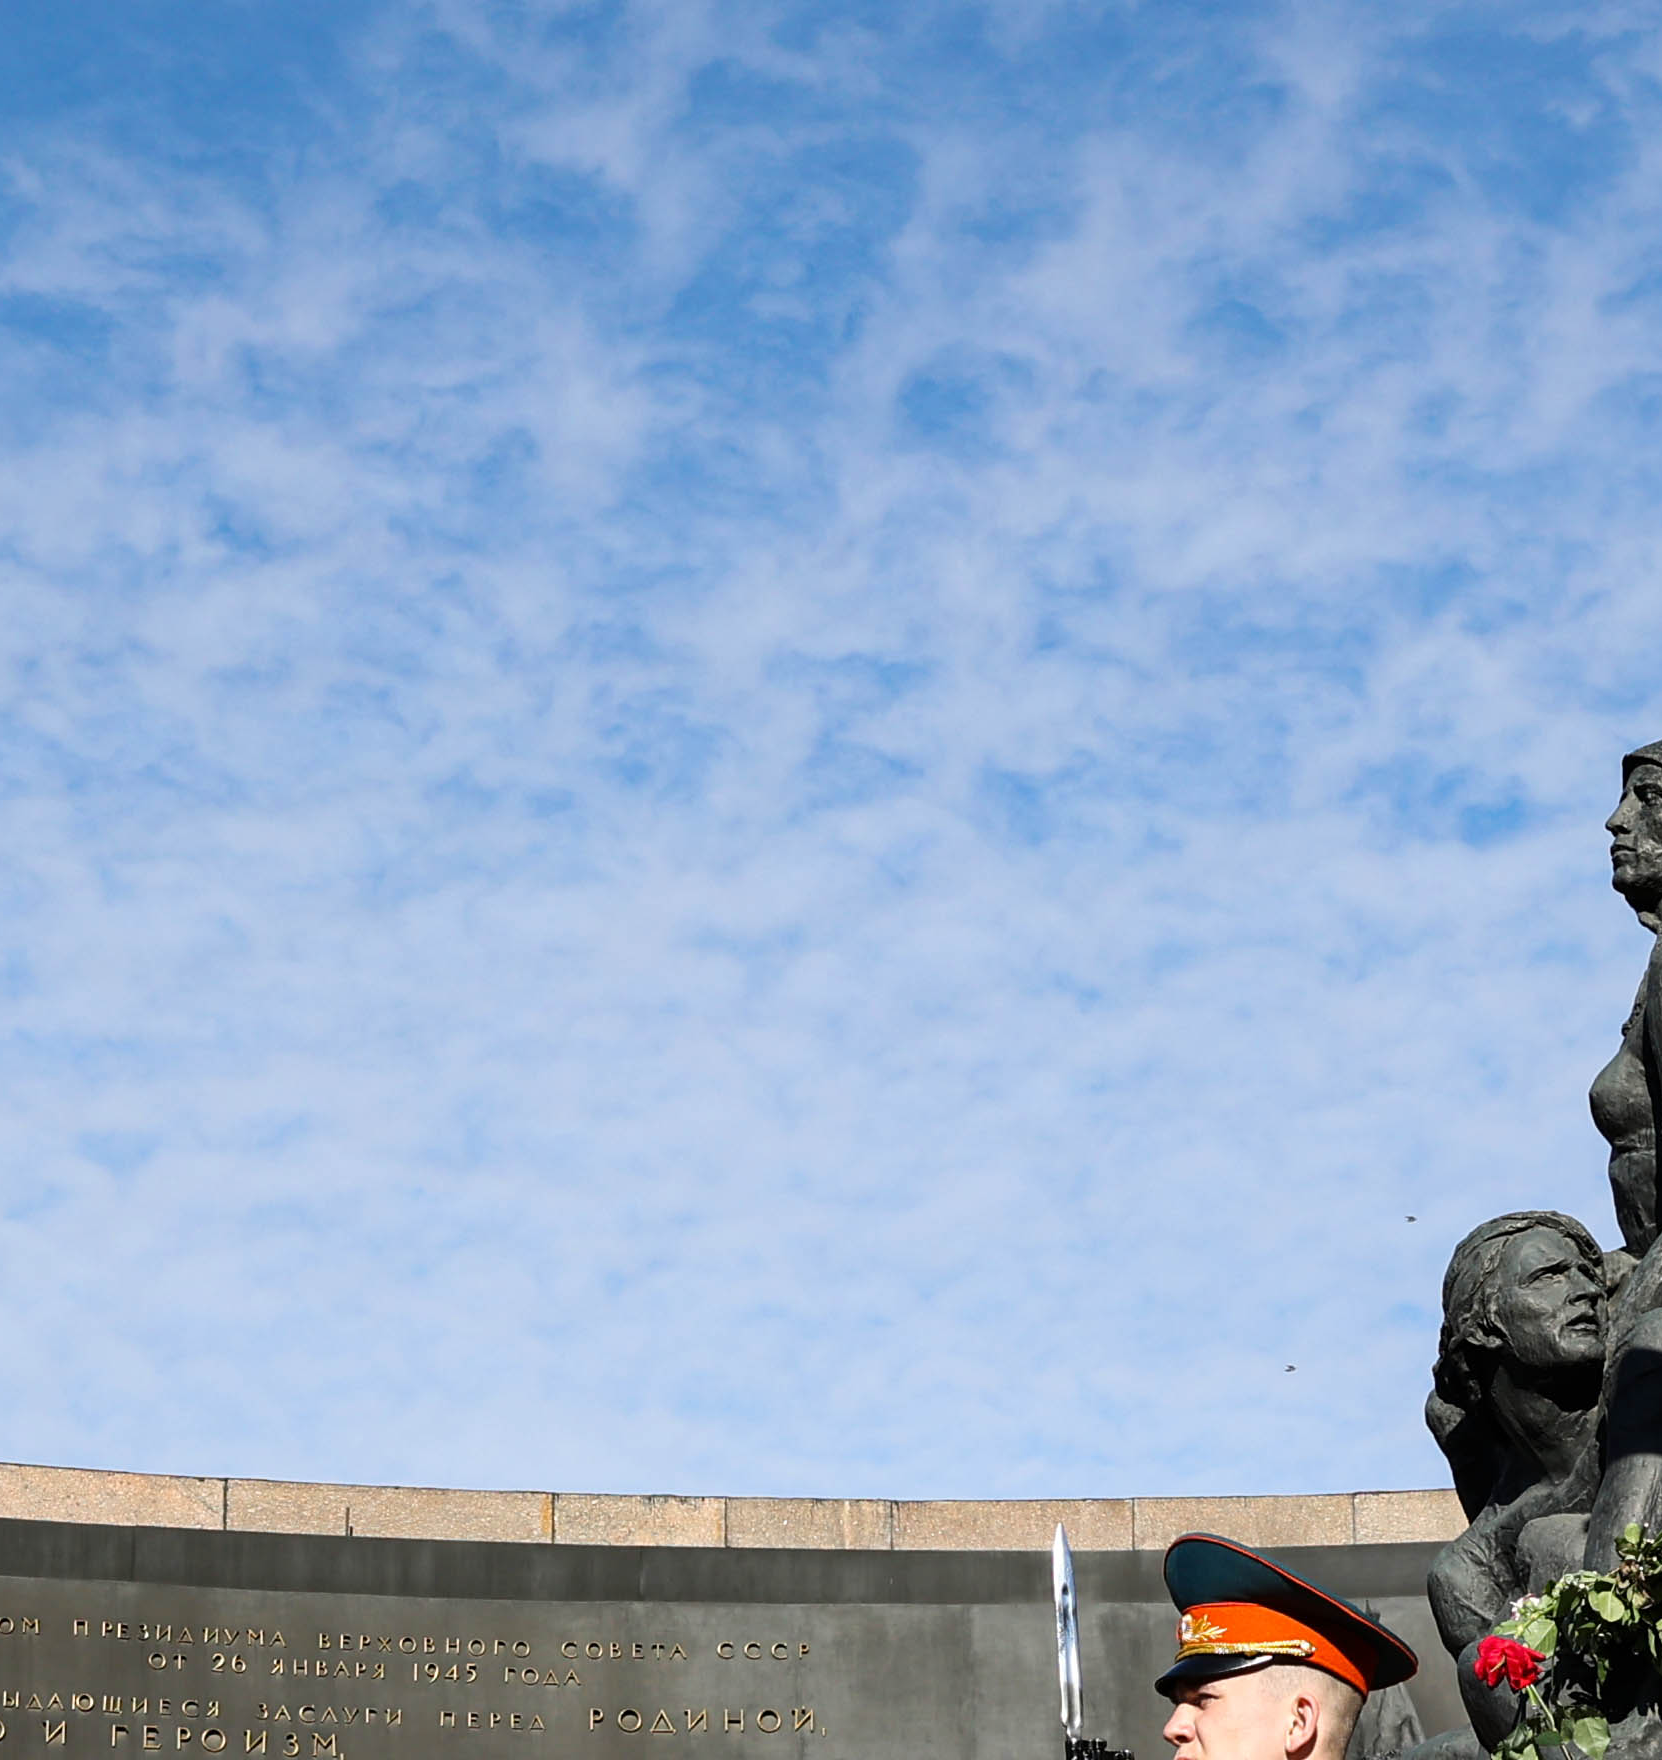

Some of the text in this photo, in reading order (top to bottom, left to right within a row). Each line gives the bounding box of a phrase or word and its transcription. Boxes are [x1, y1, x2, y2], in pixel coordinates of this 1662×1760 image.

[73, 1618, 288, 1648] ПРЕЗИДИУМА
[318, 1632, 531, 1658] ВЕРХОВНОГО
[560, 1639, 688, 1660] СОВЕТА
[716, 1641, 810, 1660] СССР
[147, 1652, 582, 1687] ОТ 26 ЯНВАРЯ 1945 ГОДА
[43, 1719, 68, 1746] И
[256, 1701, 404, 1728] ЗАСЛУГИ
[439, 1710, 547, 1731] ПЕРЕД
[589, 1705, 828, 1737] РОДИНОЙ,
